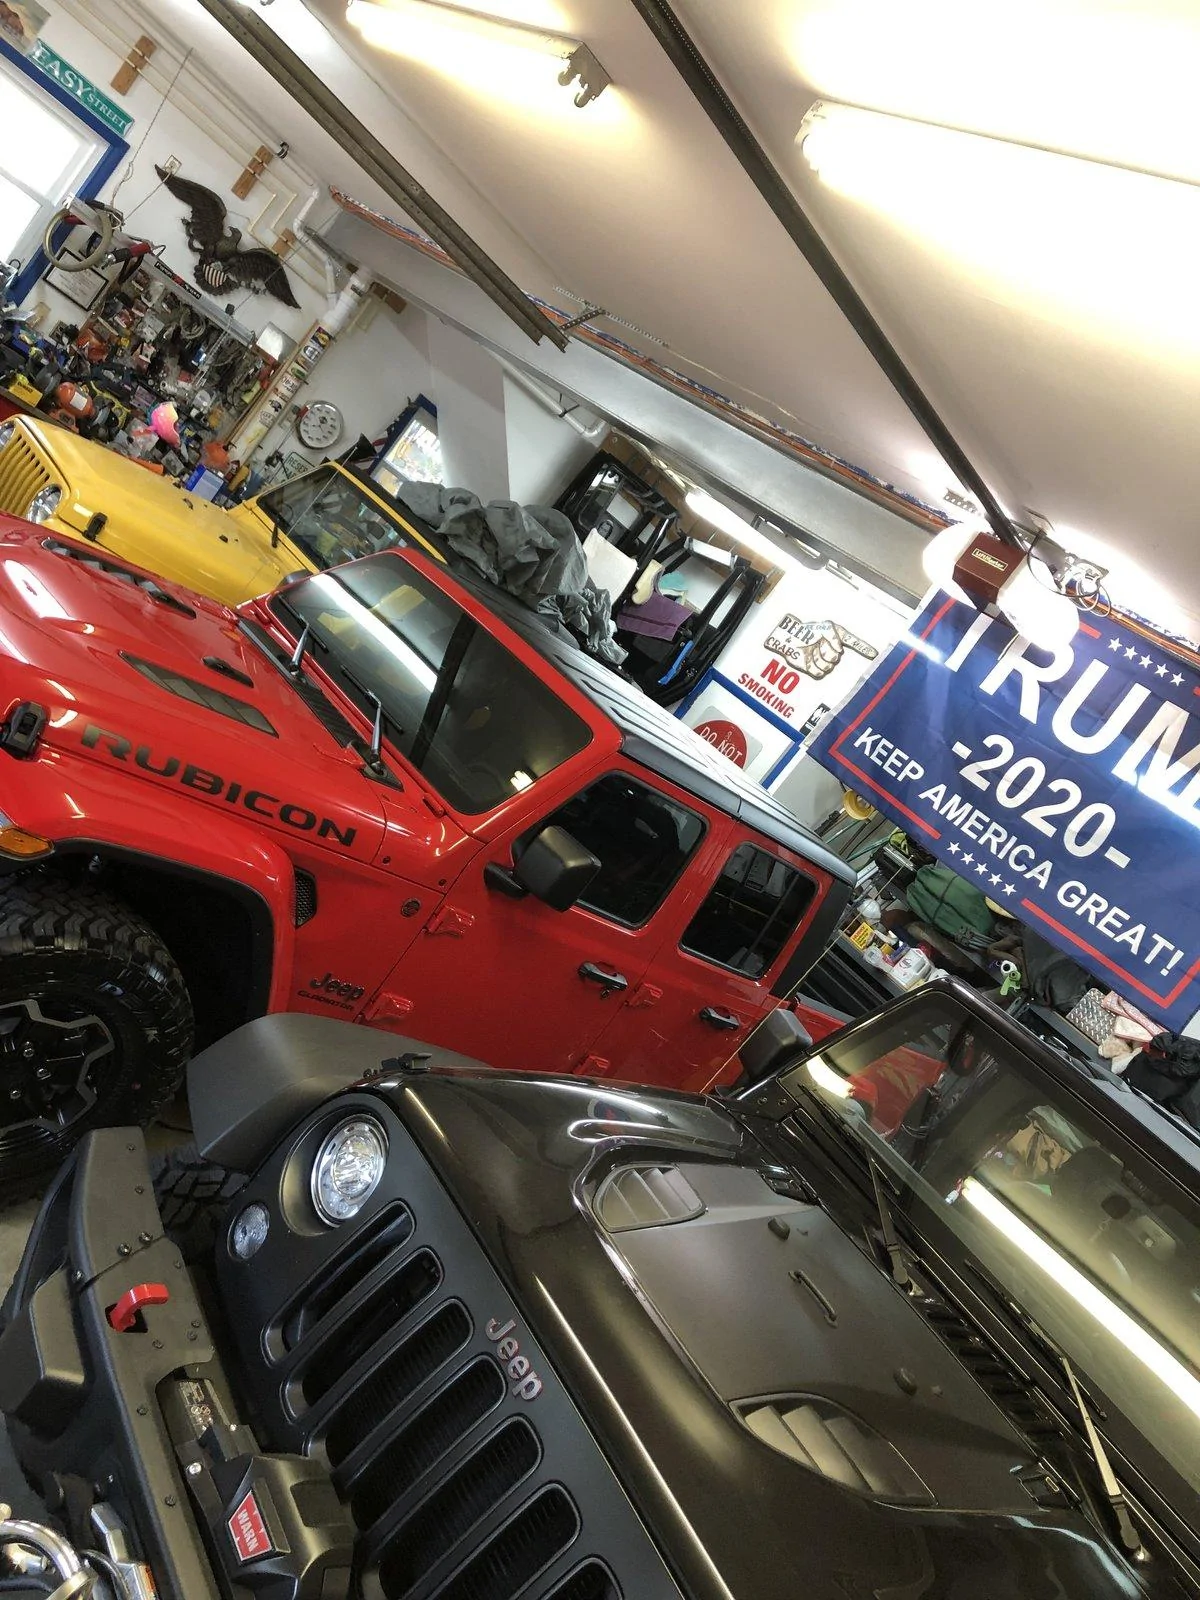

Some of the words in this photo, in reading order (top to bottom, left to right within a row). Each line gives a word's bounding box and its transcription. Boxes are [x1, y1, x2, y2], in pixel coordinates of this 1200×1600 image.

[32, 46, 92, 98] EASY
[86, 92, 127, 127] STREET
[766, 636, 801, 661] CRABS
[778, 615, 815, 646] BEER
[737, 672, 796, 720] SMOKING
[760, 658, 800, 695] NO
[700, 726, 717, 743] DO
[718, 739, 743, 763] NOT
[81, 722, 358, 848] RUBICON
[952, 732, 1132, 870] -2020-
[852, 726, 926, 783] KEEP
[918, 781, 1053, 891] AMERICA
[1056, 877, 1185, 977] GREAT!
[309, 972, 366, 1001] Jeep
[485, 1318, 543, 1402] Jeep
[237, 1507, 259, 1551] WARN
